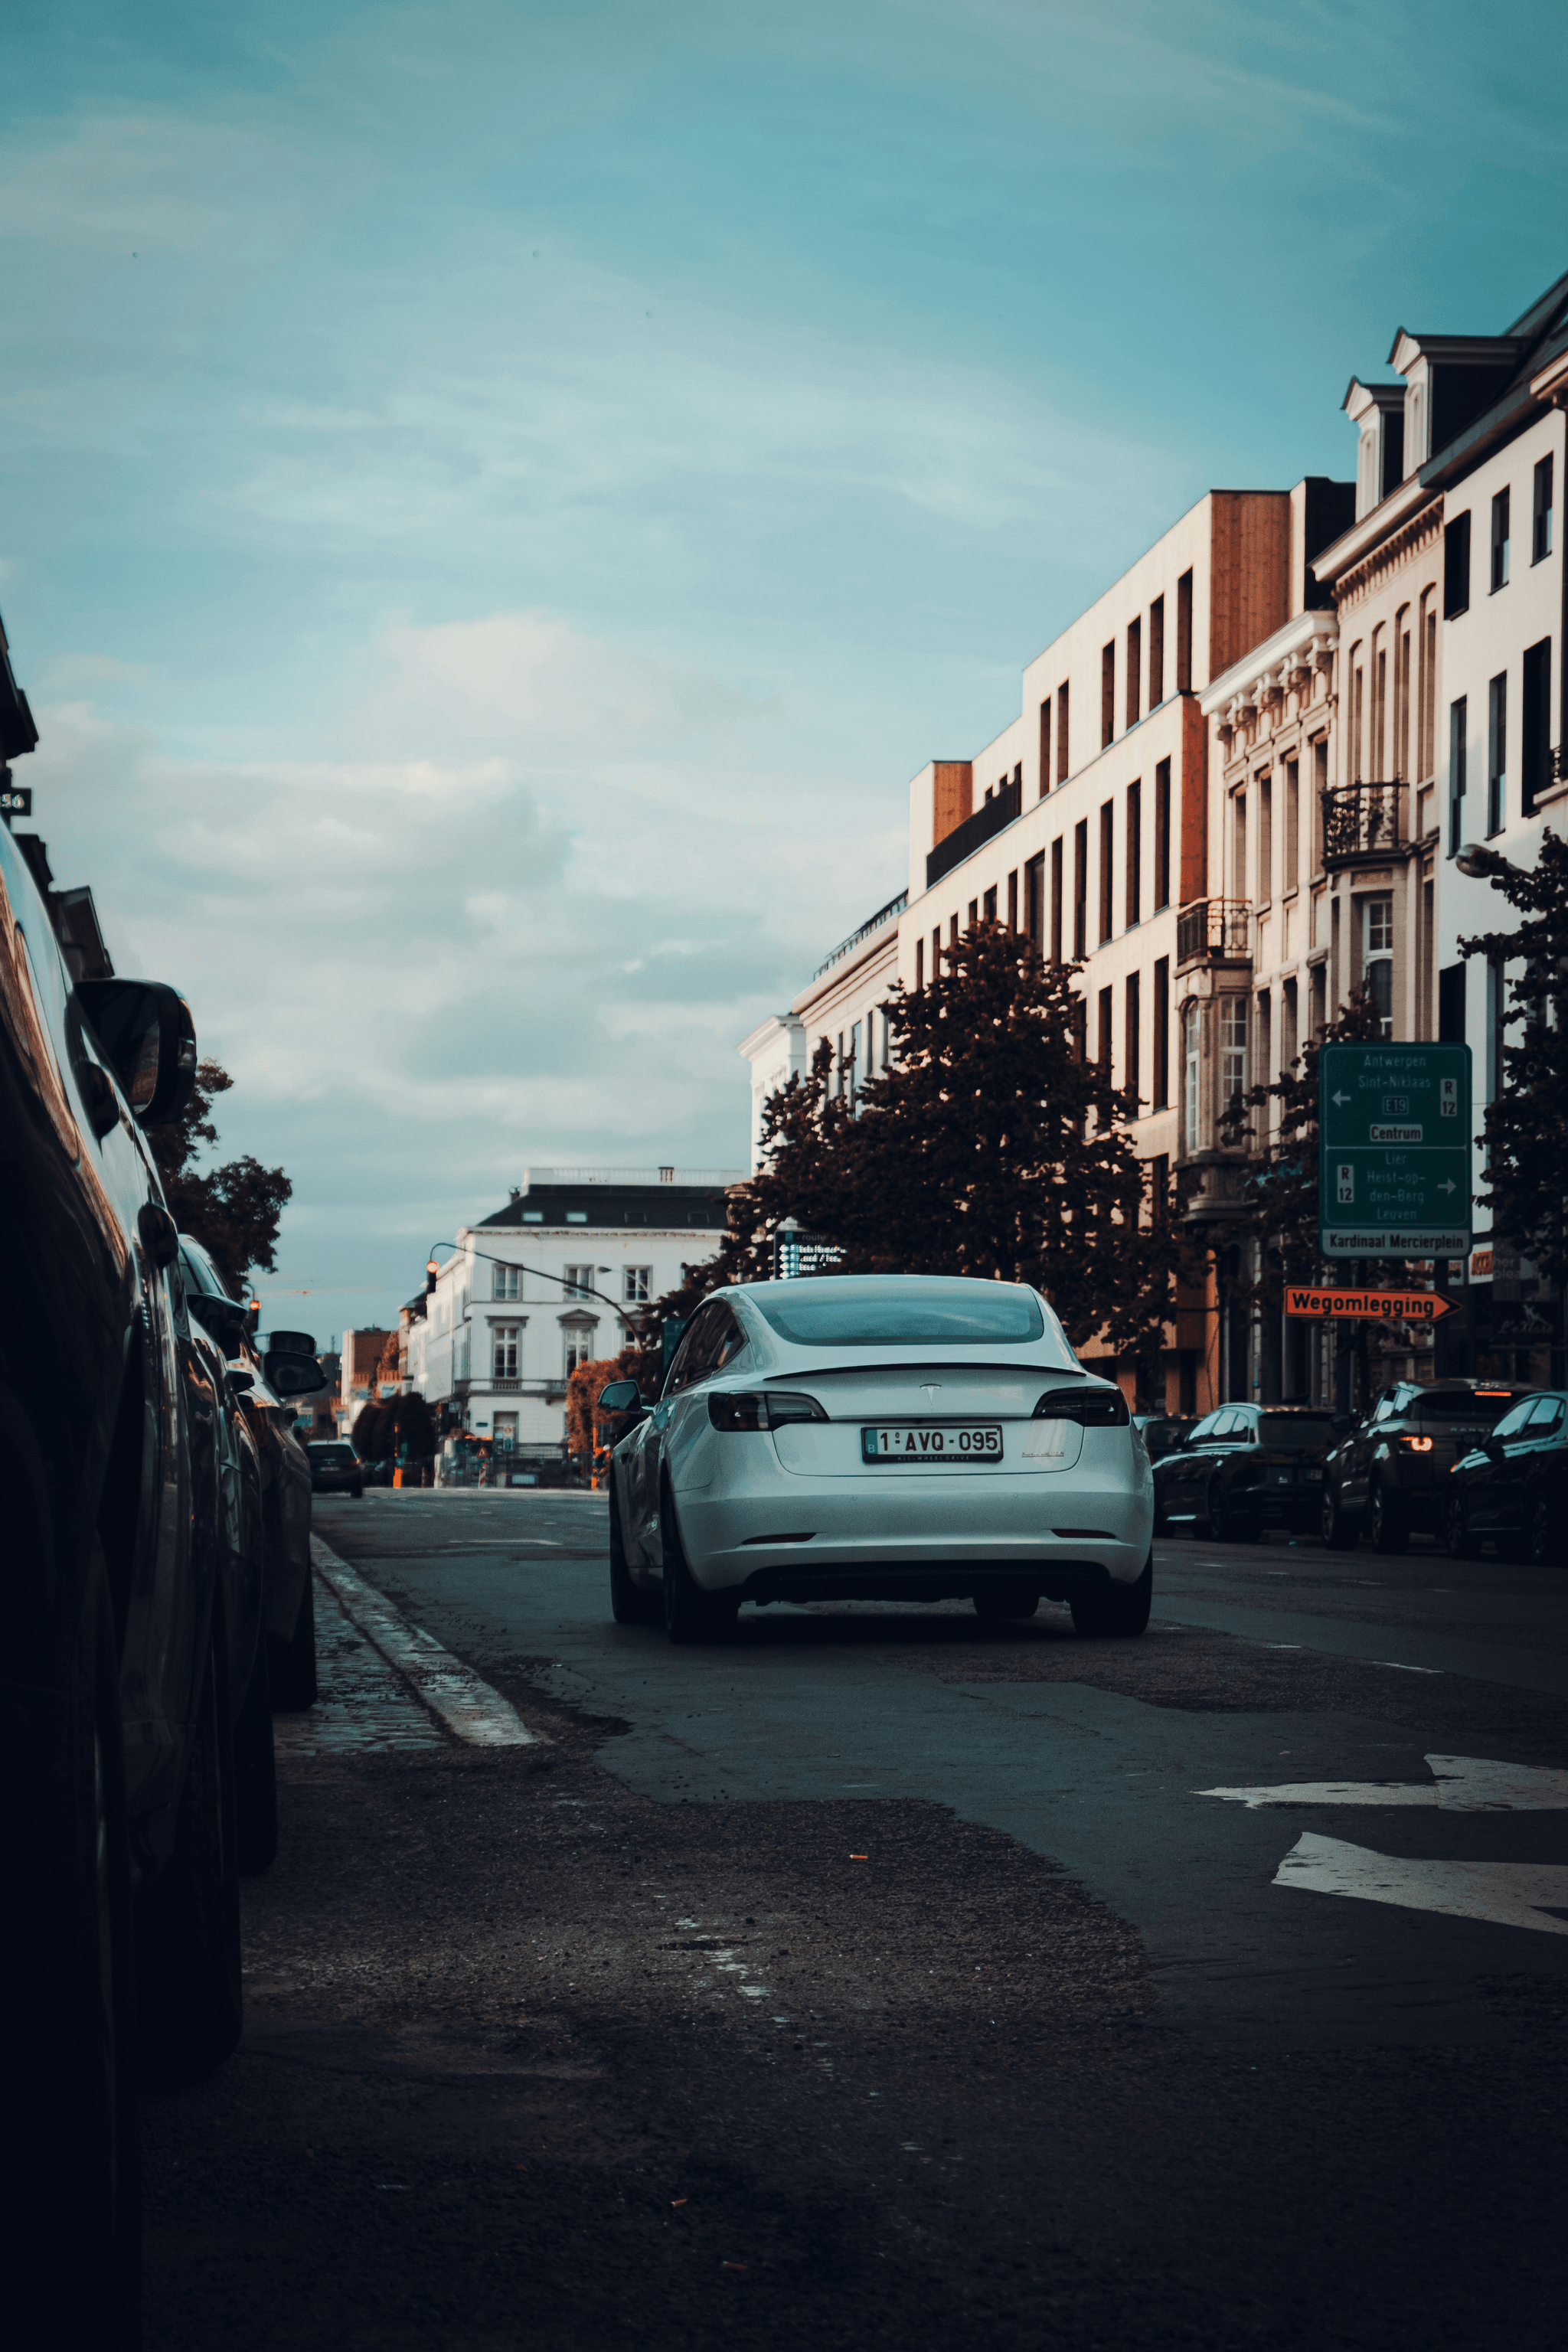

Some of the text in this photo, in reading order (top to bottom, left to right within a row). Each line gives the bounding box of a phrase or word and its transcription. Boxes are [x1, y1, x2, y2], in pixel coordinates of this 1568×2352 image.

[0, 793, 25, 809] 56
[1364, 1054, 1426, 1069] Antwerpen
[1357, 1074, 1431, 1088] Sint-Niklaas
[1444, 1080, 1453, 1094] R
[1385, 1099, 1406, 1112] E19
[1442, 1101, 1456, 1116] 12
[1370, 1125, 1422, 1140] Centrum
[1384, 1152, 1409, 1165] Lier
[1341, 1167, 1350, 1181] R
[1366, 1169, 1426, 1186] Heist-op-
[1339, 1187, 1354, 1201] 12
[1369, 1188, 1425, 1206] den-Berg
[1376, 1207, 1417, 1220] Leuven
[1329, 1234, 1464, 1252] Kardinaal Mercierplein
[1292, 1292, 1434, 1318] Wegomlegging
[867, 1444, 875, 1453] B
